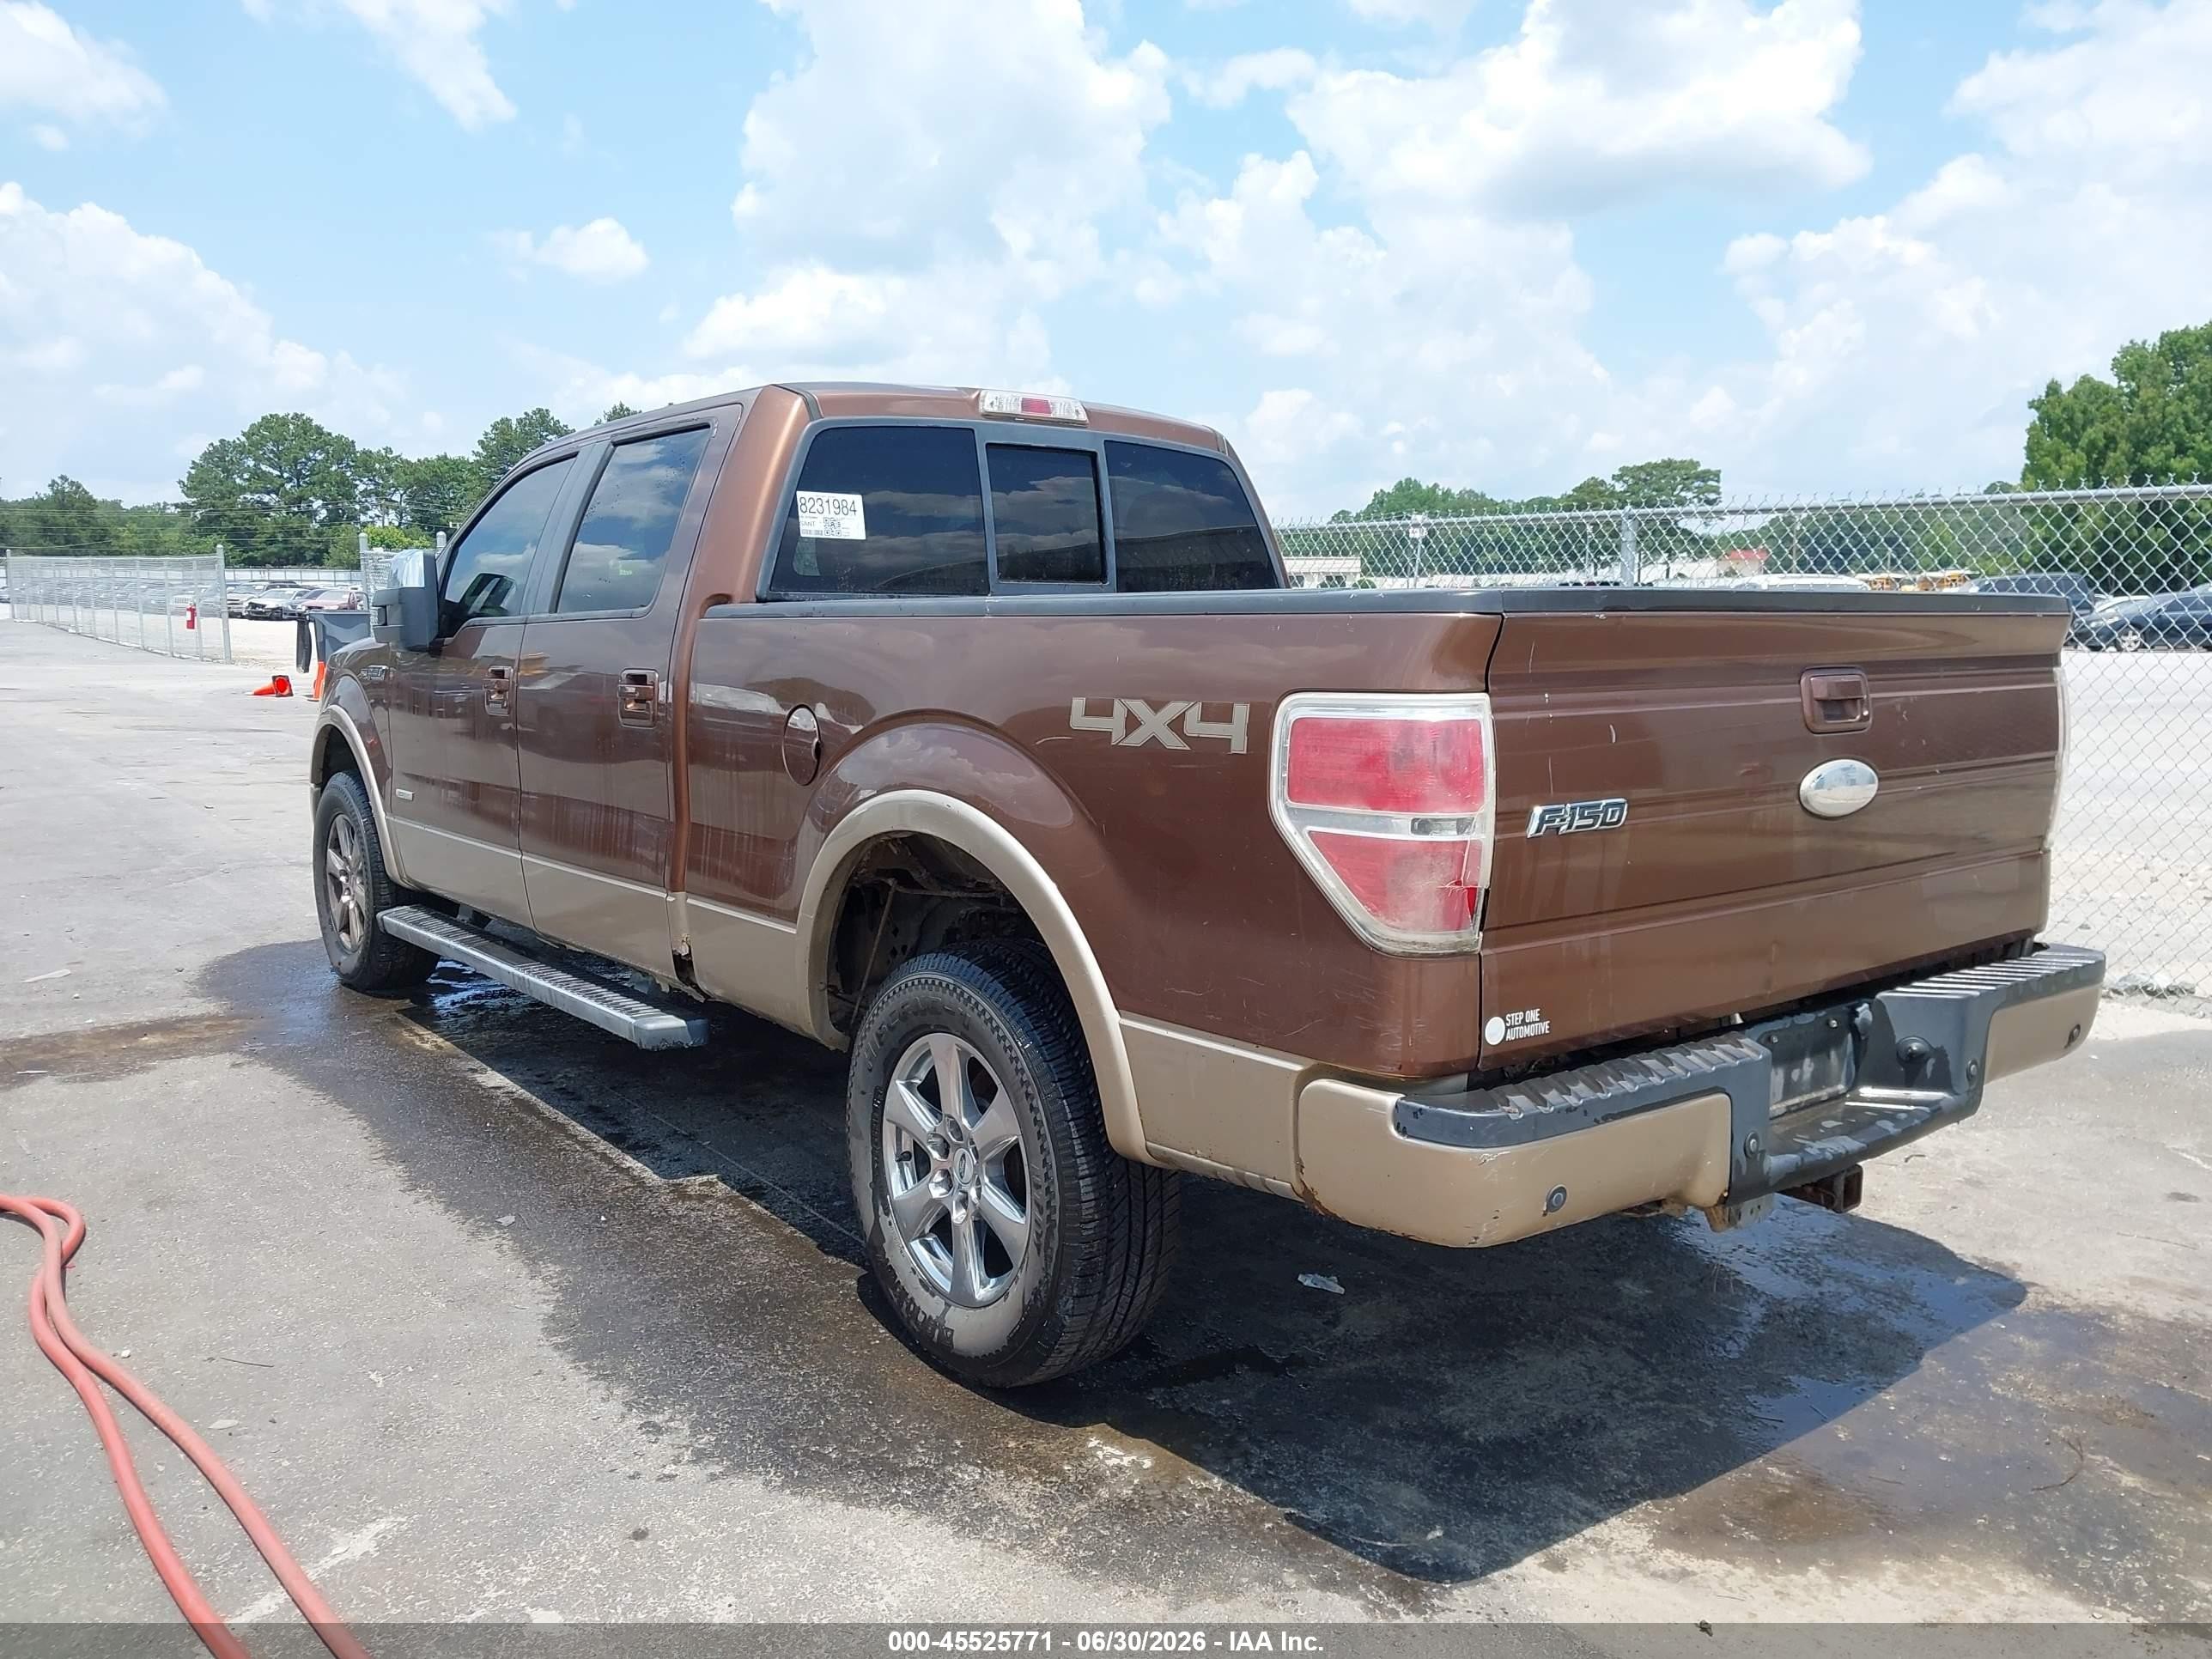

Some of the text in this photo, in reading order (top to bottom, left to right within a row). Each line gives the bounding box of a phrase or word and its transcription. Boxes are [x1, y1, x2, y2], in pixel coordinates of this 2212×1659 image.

[799, 496, 857, 516] 8231984
[1505, 1008, 1540, 1027] STEP ONE
[1505, 1020, 1551, 1042] AUTOMOTIVE
